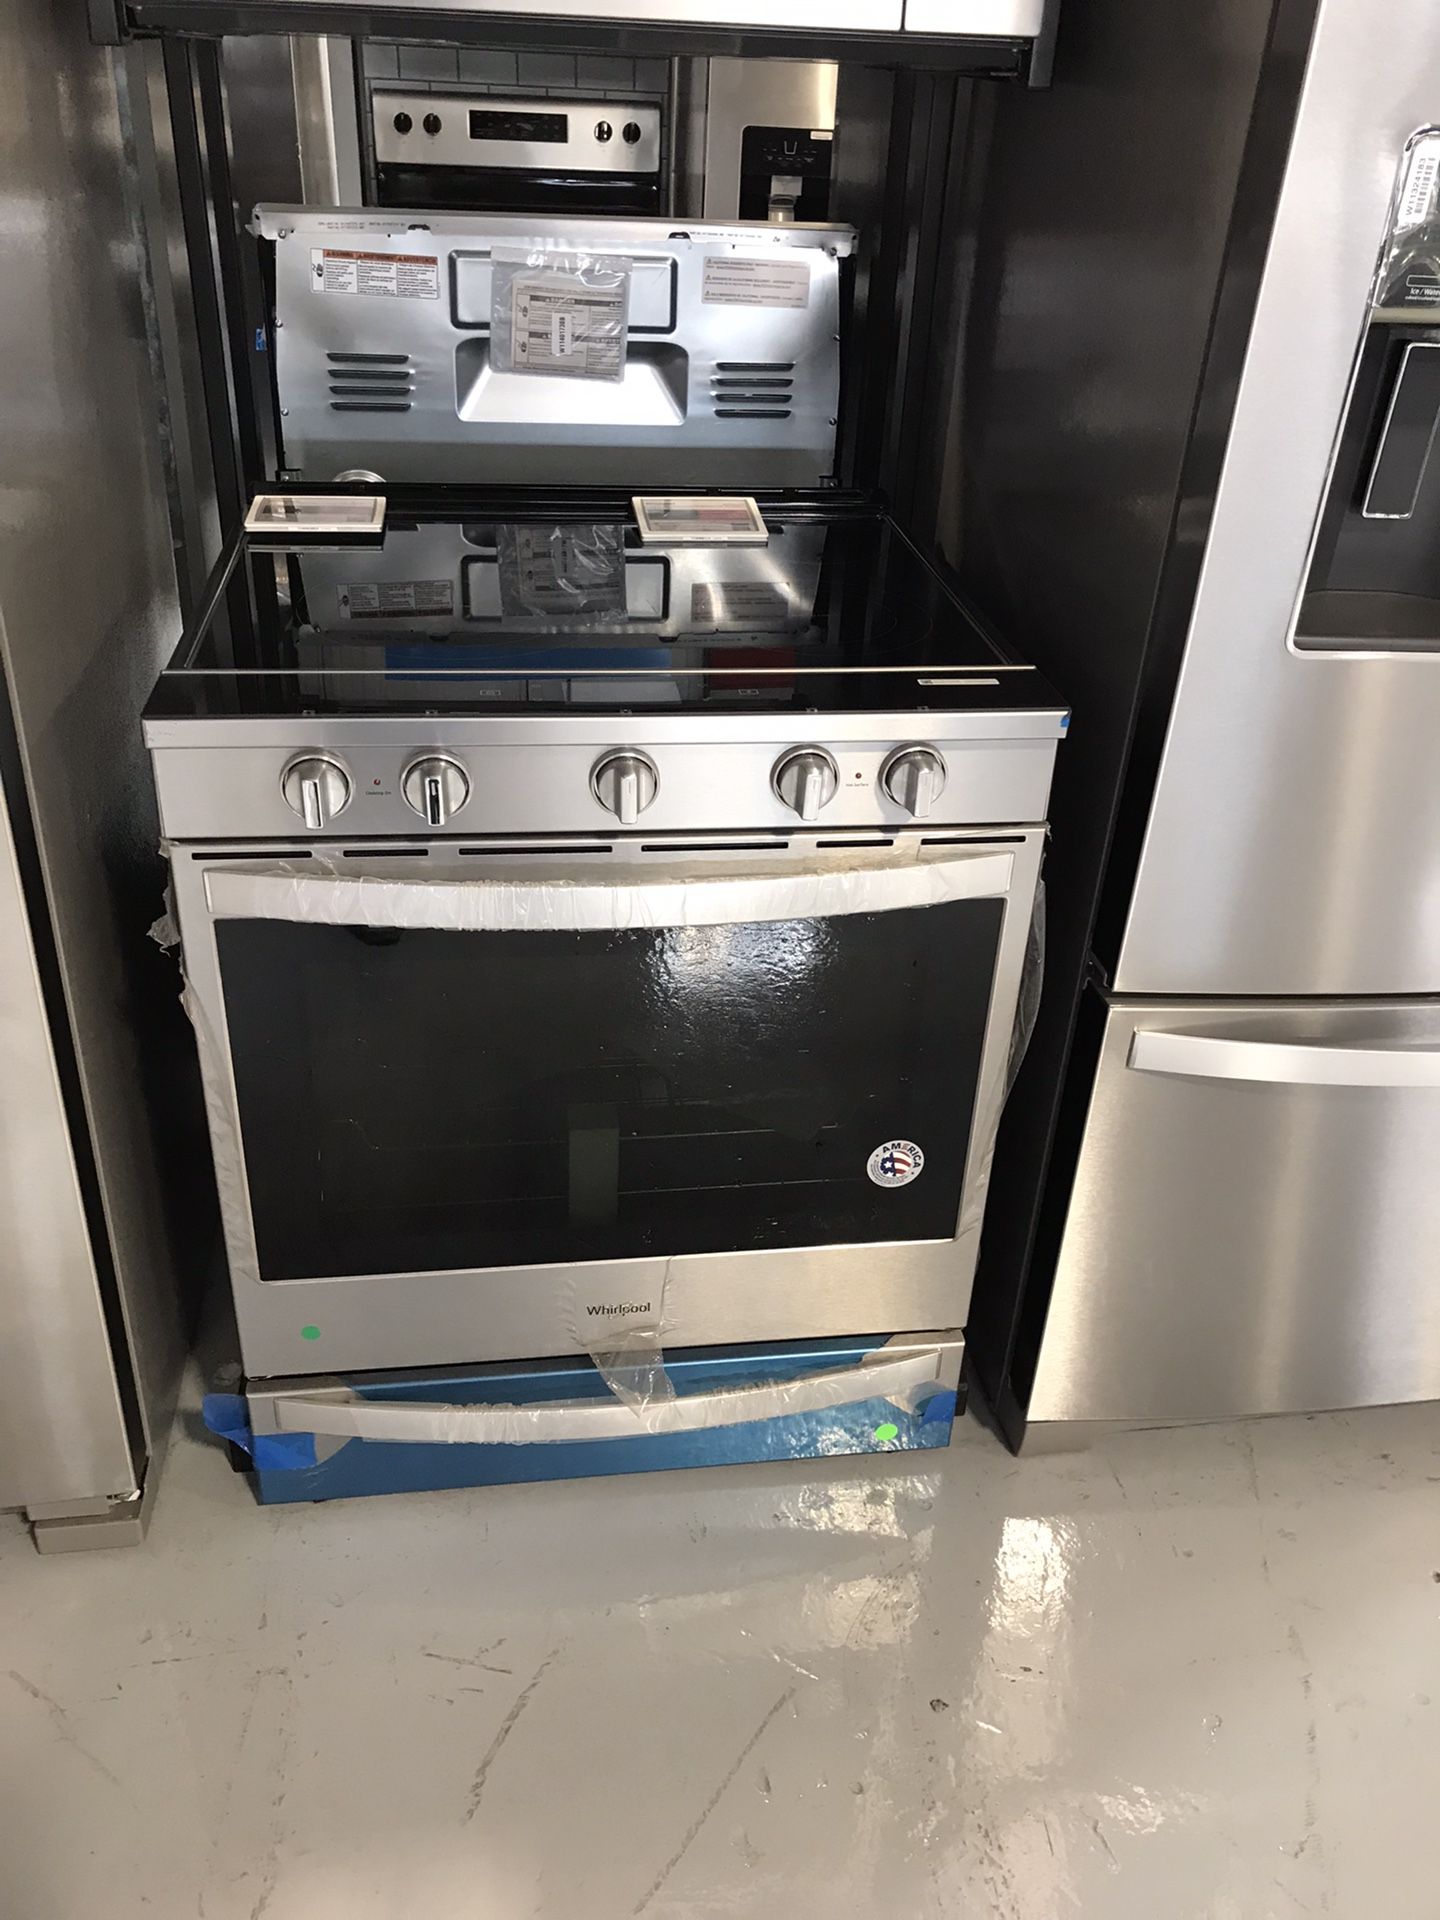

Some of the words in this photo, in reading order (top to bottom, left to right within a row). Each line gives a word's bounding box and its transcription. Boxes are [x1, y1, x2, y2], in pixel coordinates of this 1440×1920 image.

[1406, 158, 1426, 216] W11324183
[1410, 287, 1420, 295] Ice
[586, 1302, 650, 1317] Whirlpool
